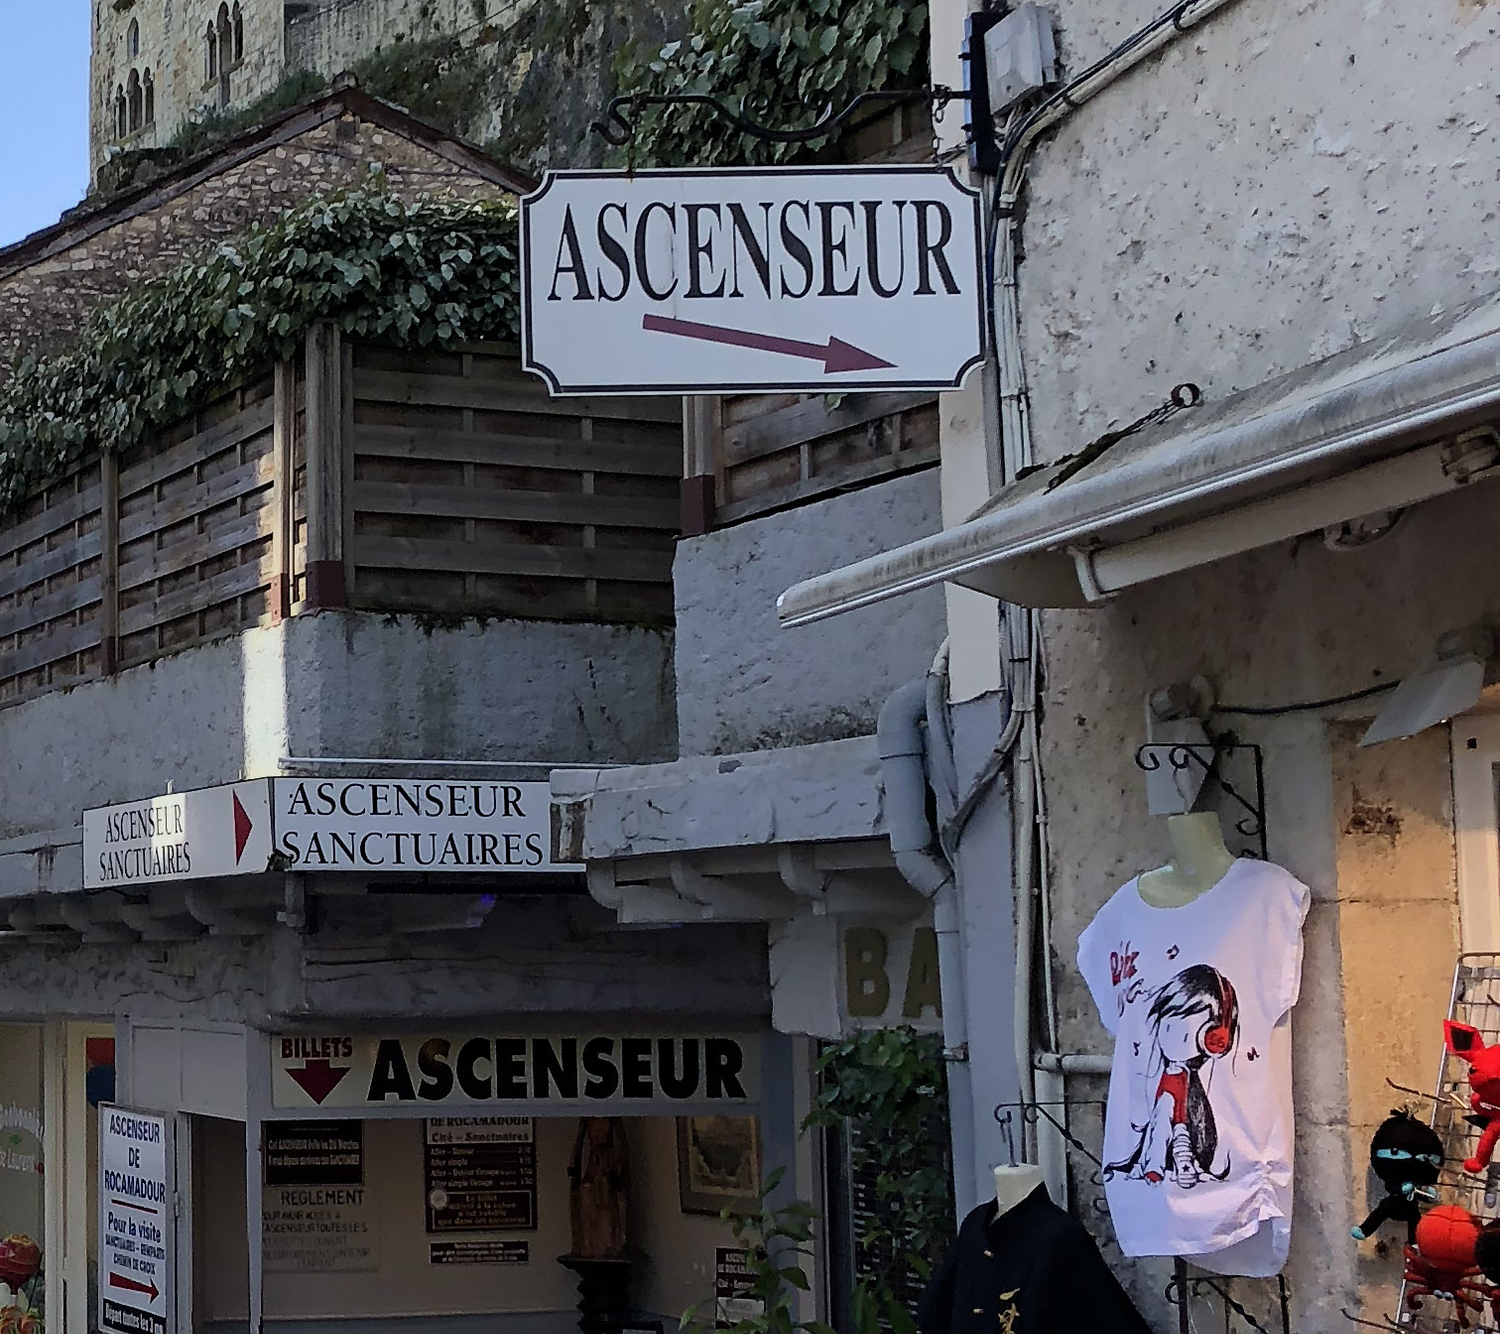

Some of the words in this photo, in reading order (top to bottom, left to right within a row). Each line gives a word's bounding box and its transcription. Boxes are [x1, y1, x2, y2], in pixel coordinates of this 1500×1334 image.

[547, 199, 962, 302] ASCENSEUR
[287, 782, 527, 818] ASCENSEUR
[104, 803, 184, 845] ASCENSEUR
[98, 845, 192, 883] SANCTUAIRES
[281, 830, 544, 867] SANCTUAIRES
[281, 1036, 353, 1060] BILLETS
[366, 1037, 748, 1102] ASCENSEUR
[109, 1114, 160, 1144] ASCENSEUR
[465, 1130, 530, 1142] Sanctuaires
[128, 1146, 140, 1169] DE
[104, 1169, 166, 1204] ROCAMADOUR
[281, 1189, 364, 1206] REGLEMENT
[108, 1211, 127, 1233] Pour
[128, 1216, 137, 1236] la
[138, 1220, 161, 1244] visite
